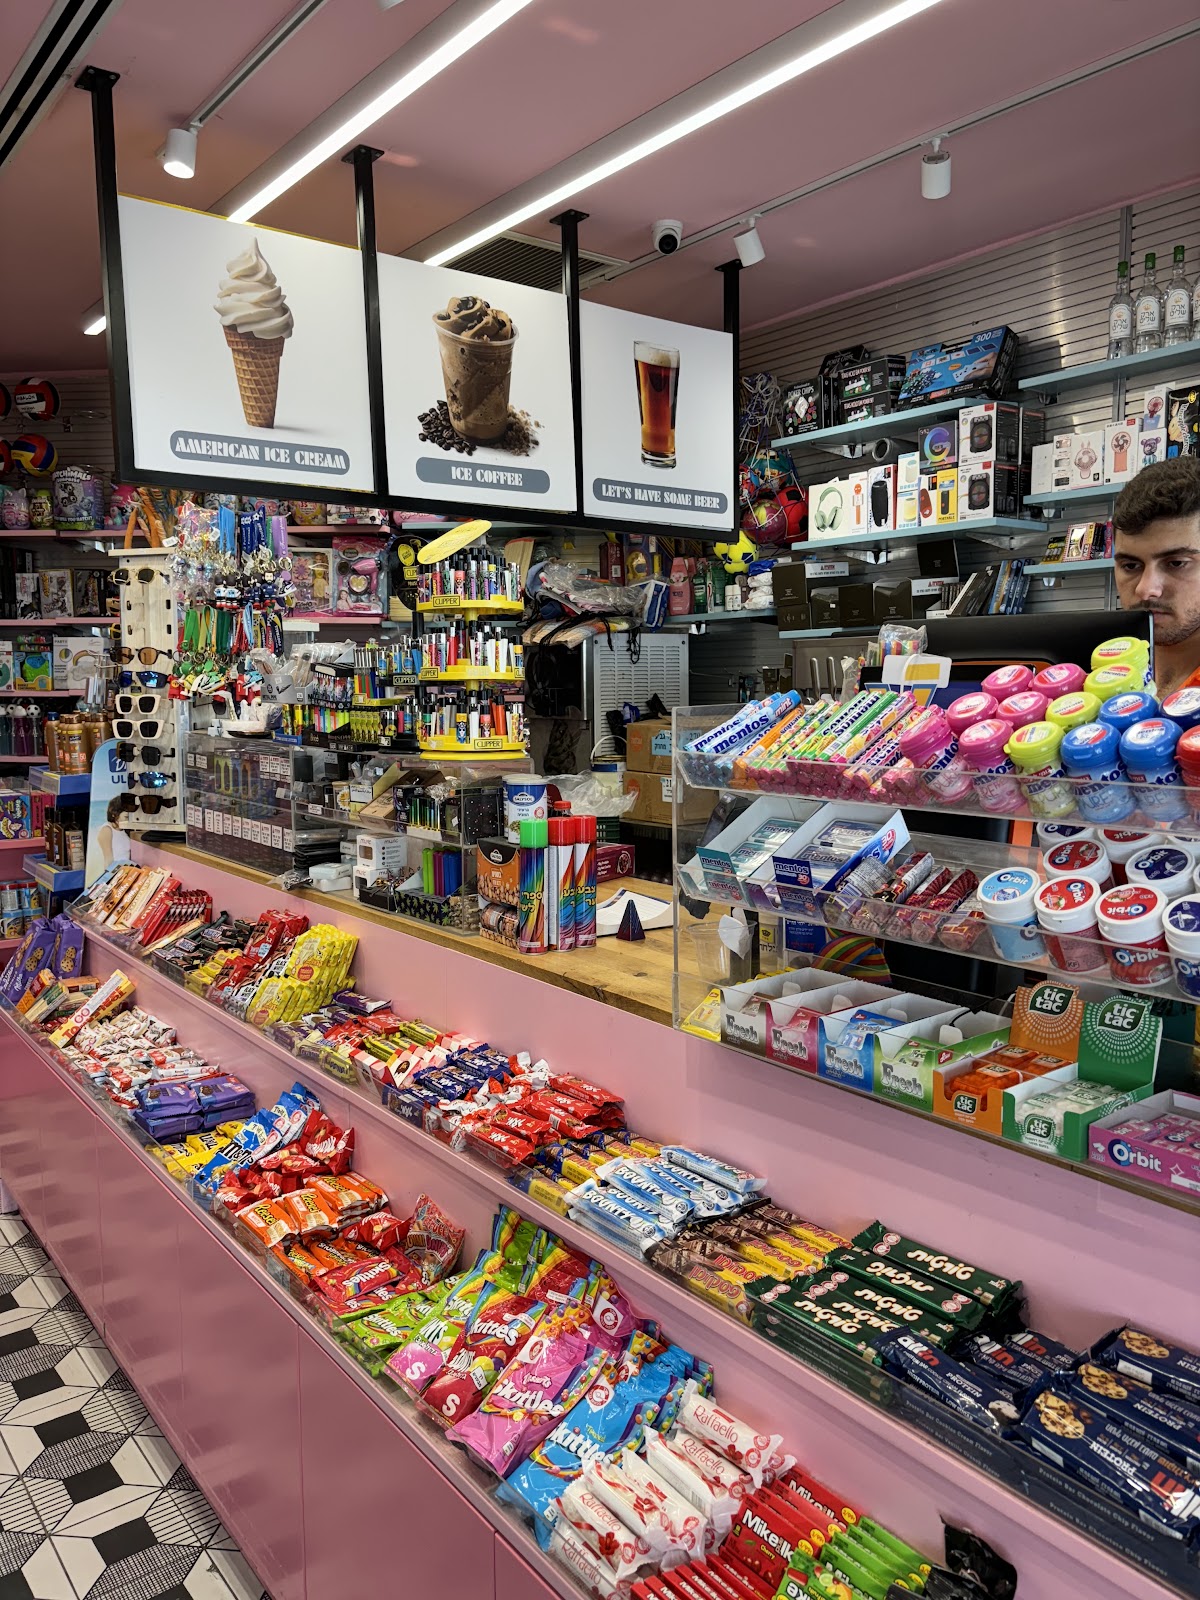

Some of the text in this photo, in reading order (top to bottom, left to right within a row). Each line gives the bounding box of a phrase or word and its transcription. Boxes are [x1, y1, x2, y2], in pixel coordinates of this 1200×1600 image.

[975, 332, 992, 343] 300
[175, 436, 347, 470] AMERICAN ICE CREAM
[451, 466, 523, 487] ICE COFFEE
[601, 483, 720, 509] LET'S HAVE SOME BEER
[435, 597, 459, 606] CLIPPER
[394, 675, 417, 685] CLIPPER
[713, 697, 793, 754] mentos mint
[476, 740, 502, 749] CLIPPER
[830, 827, 873, 837] mentos
[881, 832, 893, 844] 30
[701, 856, 731, 869] mentos
[802, 852, 844, 863] mentos
[1052, 843, 1074, 866] Orbit
[1135, 849, 1168, 870] Orbit
[774, 862, 809, 875] mentos
[998, 872, 1029, 886] Orbit
[521, 891, 543, 901] ספרי
[708, 880, 739, 892] mentos
[780, 891, 814, 904] mentos
[1069, 881, 1086, 904] Orbit
[1107, 903, 1147, 915] Orbit
[1114, 947, 1160, 964] Orbit
[1036, 998, 1064, 1013] tac
[1043, 986, 1067, 1002] tic
[1104, 1012, 1134, 1029] tac
[1112, 1003, 1137, 1019] tic
[725, 1014, 759, 1044] Fresh
[771, 1028, 808, 1060] Fresh
[825, 1044, 864, 1078] Fresh
[880, 1062, 924, 1098] Fresh
[957, 1103, 973, 1113] tac
[960, 1095, 973, 1105] tic
[1029, 1127, 1048, 1137] tac
[1034, 1119, 1048, 1130] tic
[1169, 1129, 1194, 1142] Orbit
[1108, 1143, 1162, 1172] Orbit
[616, 1166, 667, 1197] BOUNTY
[301, 1193, 320, 1213] Reese's
[584, 1189, 631, 1220] BOUNTY
[342, 1262, 392, 1287] Skittles
[906, 1247, 974, 1281] טורטית
[868, 1260, 935, 1293] טורטית
[854, 1287, 923, 1322] טורטית
[363, 1313, 402, 1336] Skittles
[794, 1298, 863, 1335] טורטית
[405, 1361, 426, 1380] S
[945, 1371, 983, 1398] PROTEIN
[441, 1393, 461, 1417] S
[1132, 1402, 1183, 1430] PROTEIN
[693, 1404, 739, 1445] Raffaello
[906, 1400, 993, 1457] Protein Bar Cookies Cream Flavor
[681, 1437, 725, 1476] Raffaello
[915, 1417, 935, 1433] Protein
[944, 1436, 963, 1451] Vanilla
[982, 1462, 1001, 1478] Flavor
[1089, 1440, 1137, 1477] PROTEIN
[578, 1490, 622, 1533] Raffaello
[1038, 1467, 1155, 1542] Protein Bar Chocolate Chip Flavor
[742, 1508, 780, 1544] Mike
[1049, 1502, 1075, 1523] Protein
[1075, 1518, 1087, 1529] Bar
[1088, 1525, 1125, 1556] Chocolate
[561, 1535, 603, 1585] Raffaello
[759, 1543, 776, 1561] Cherry
